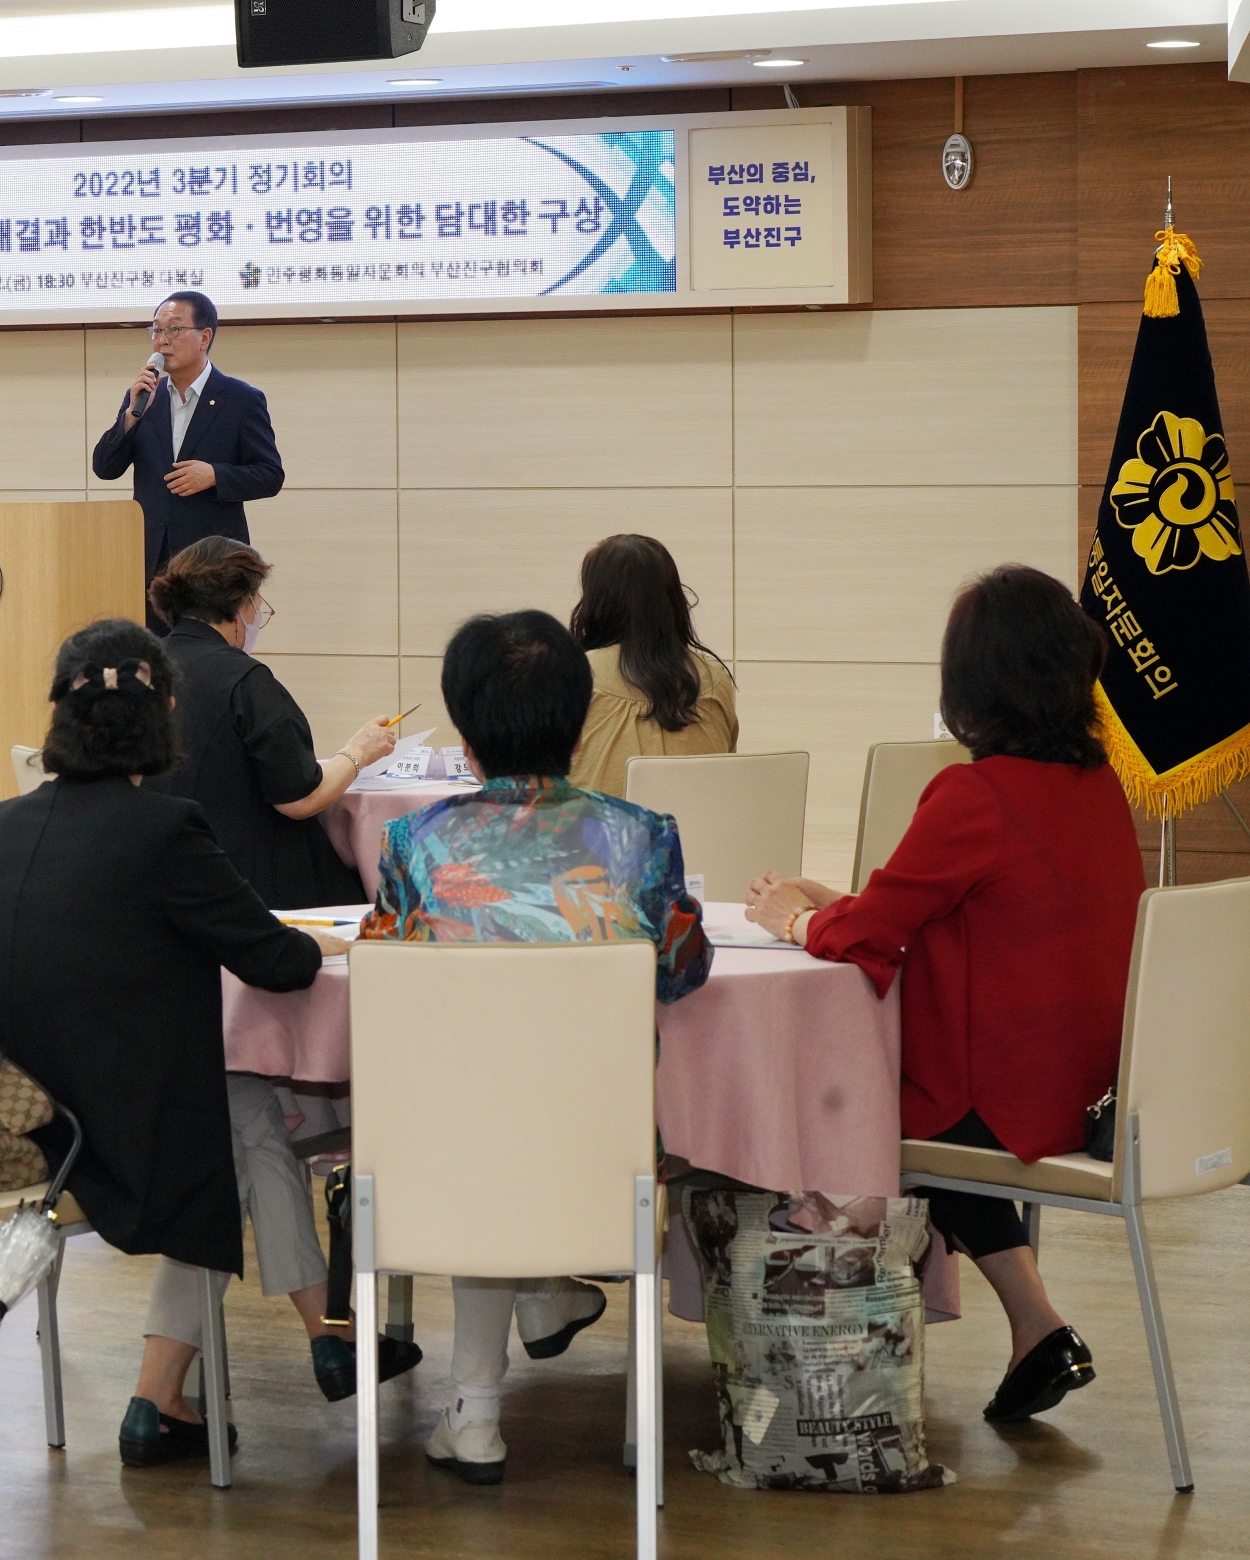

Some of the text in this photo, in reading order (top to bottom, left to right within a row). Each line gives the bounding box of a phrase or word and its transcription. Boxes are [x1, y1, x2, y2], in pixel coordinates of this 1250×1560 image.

[74, 160, 353, 198] 2022년 3분기 정기회의
[708, 161, 816, 185] 부산의 중심,
[723, 194, 802, 216] 도약하는
[79, 213, 167, 250] 한반도
[174, 210, 235, 249] 평화
[265, 207, 356, 244] 번영을
[363, 203, 426, 240] 위한
[435, 199, 532, 238] 담대한
[537, 196, 605, 235] 구상
[723, 226, 802, 249] 부산진구
[37, 273, 76, 289] 18:30
[81, 269, 155, 289] 부산진구청
[267, 261, 425, 284] 민주평화통일자문회의
[1089, 533, 1179, 701] 통일자문회의
[812, 1321, 866, 1338] ENERGY
[799, 1413, 892, 1436] BEAUTY STYLE
